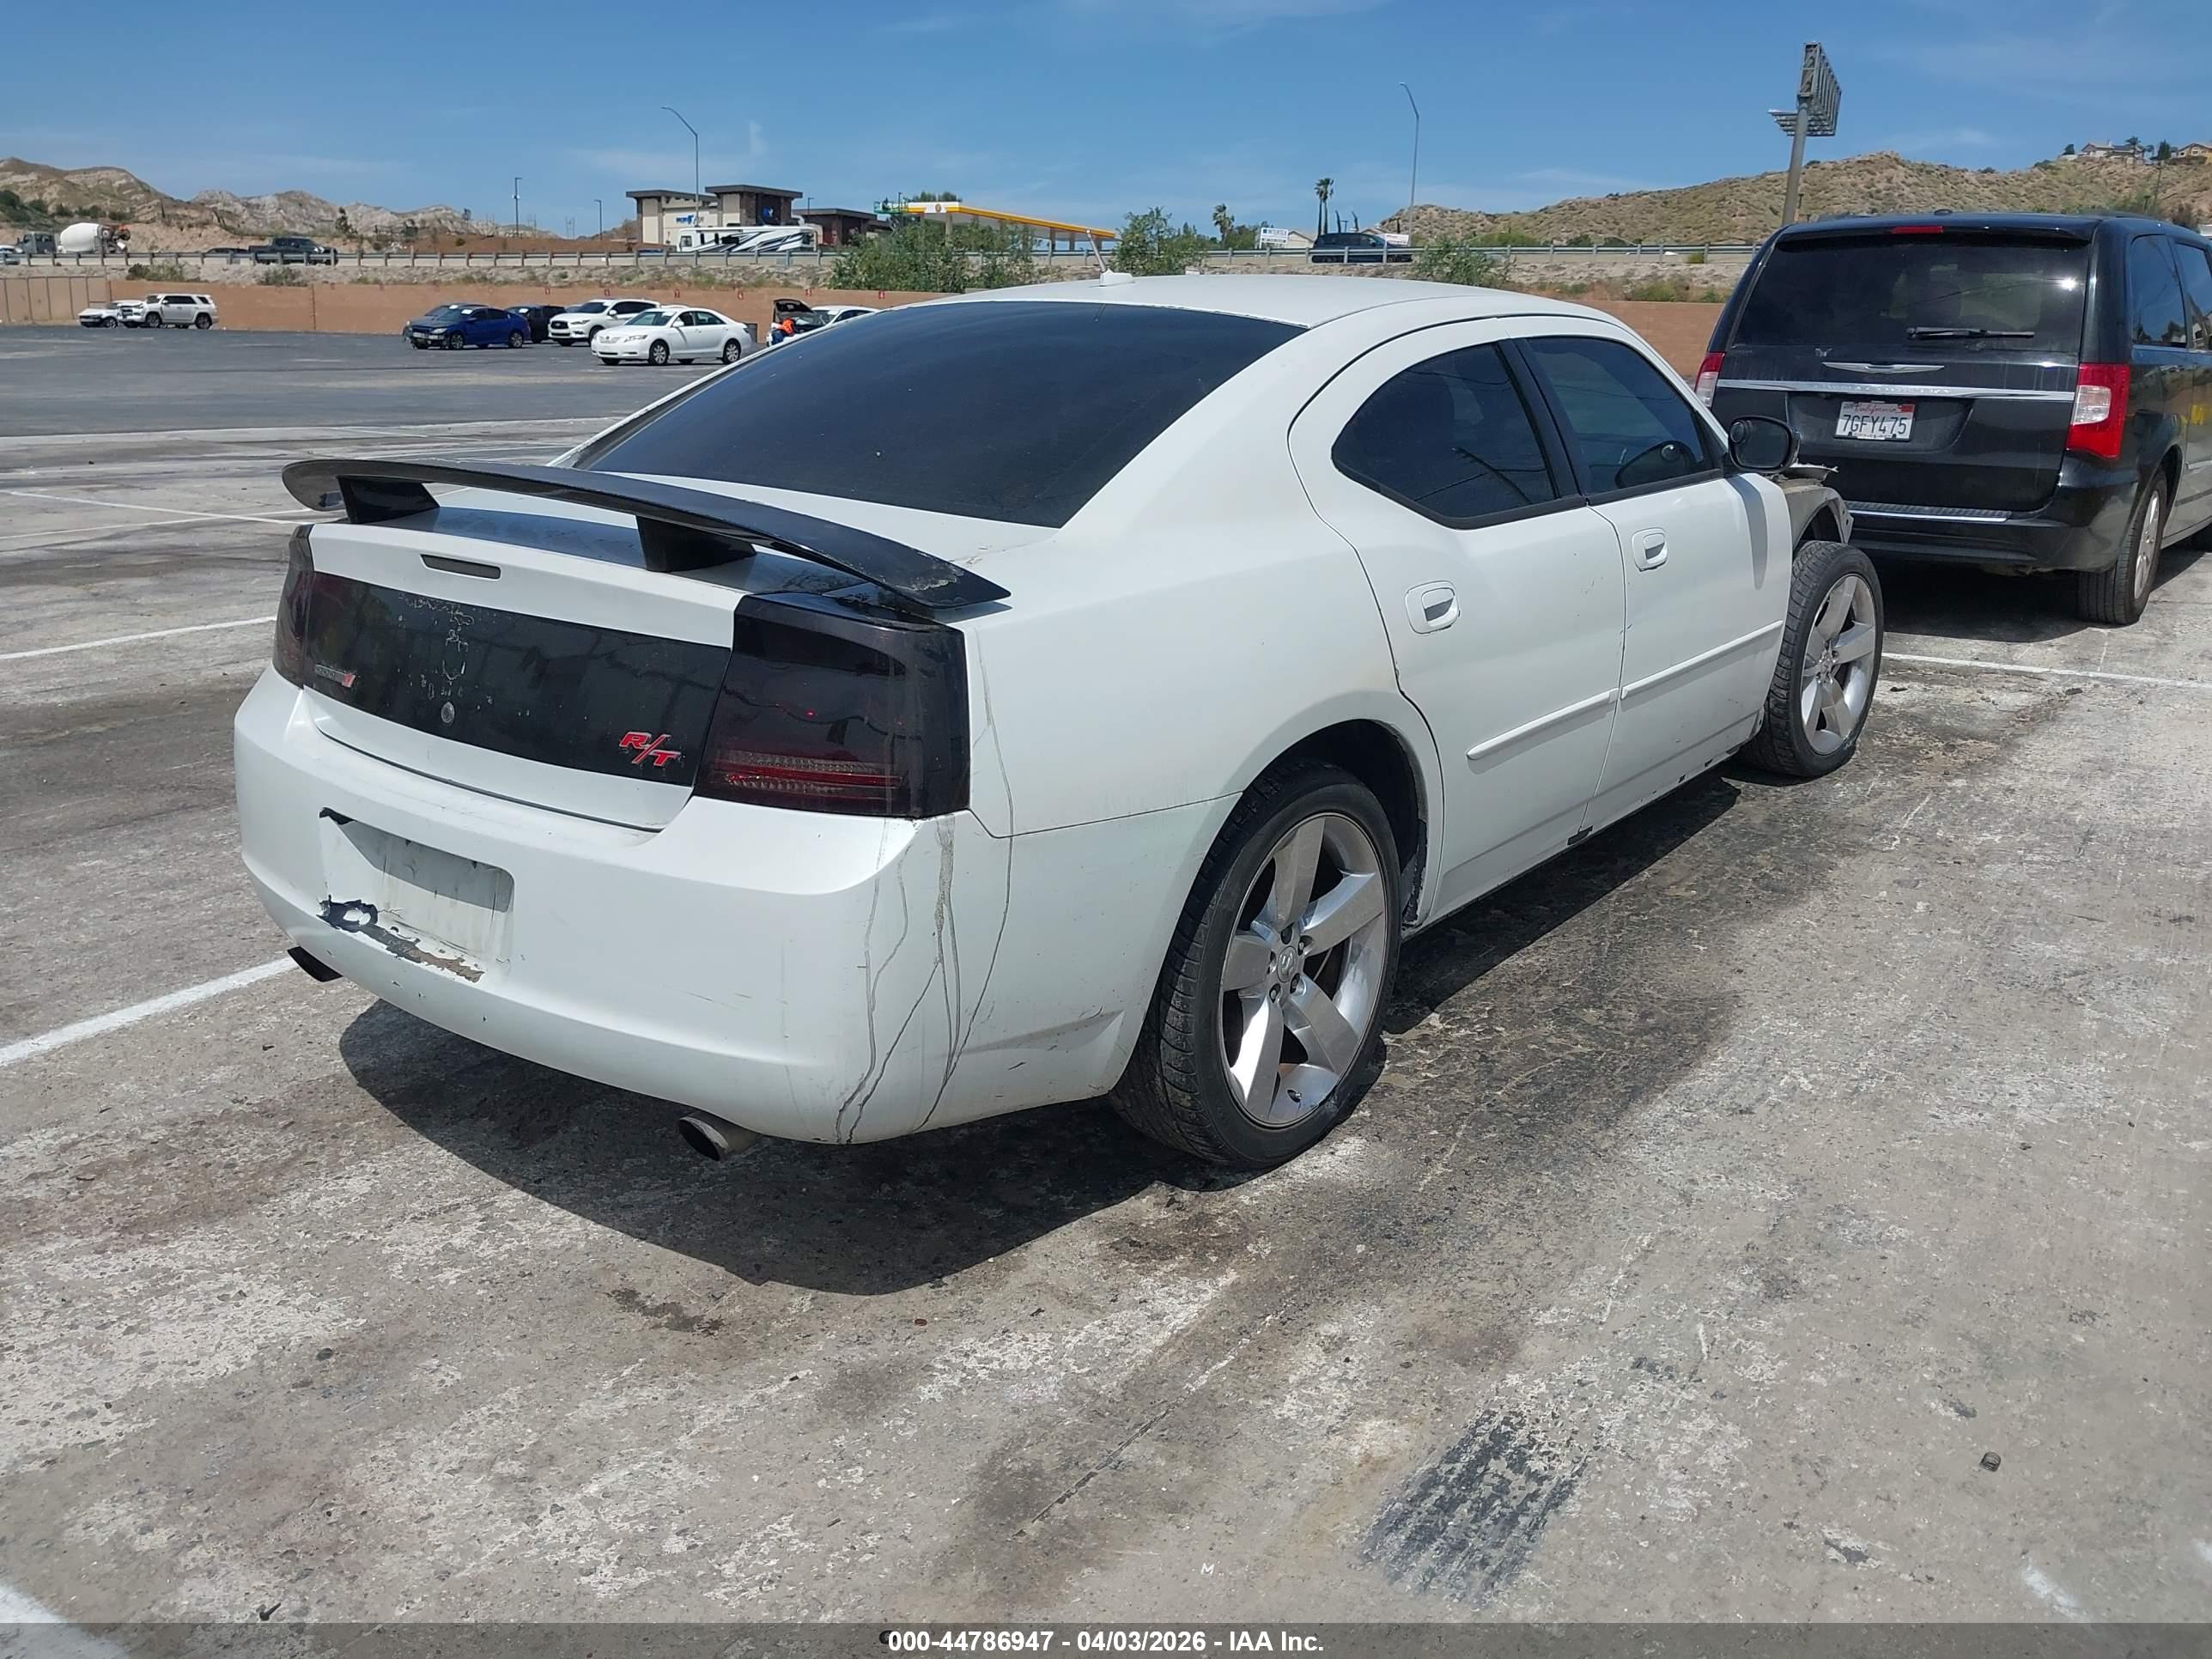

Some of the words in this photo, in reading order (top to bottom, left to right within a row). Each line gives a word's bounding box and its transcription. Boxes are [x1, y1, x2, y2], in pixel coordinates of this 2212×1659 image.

[1854, 403, 1897, 415] California
[1842, 414, 1908, 435] 7GFY475
[618, 731, 681, 767] R/T
